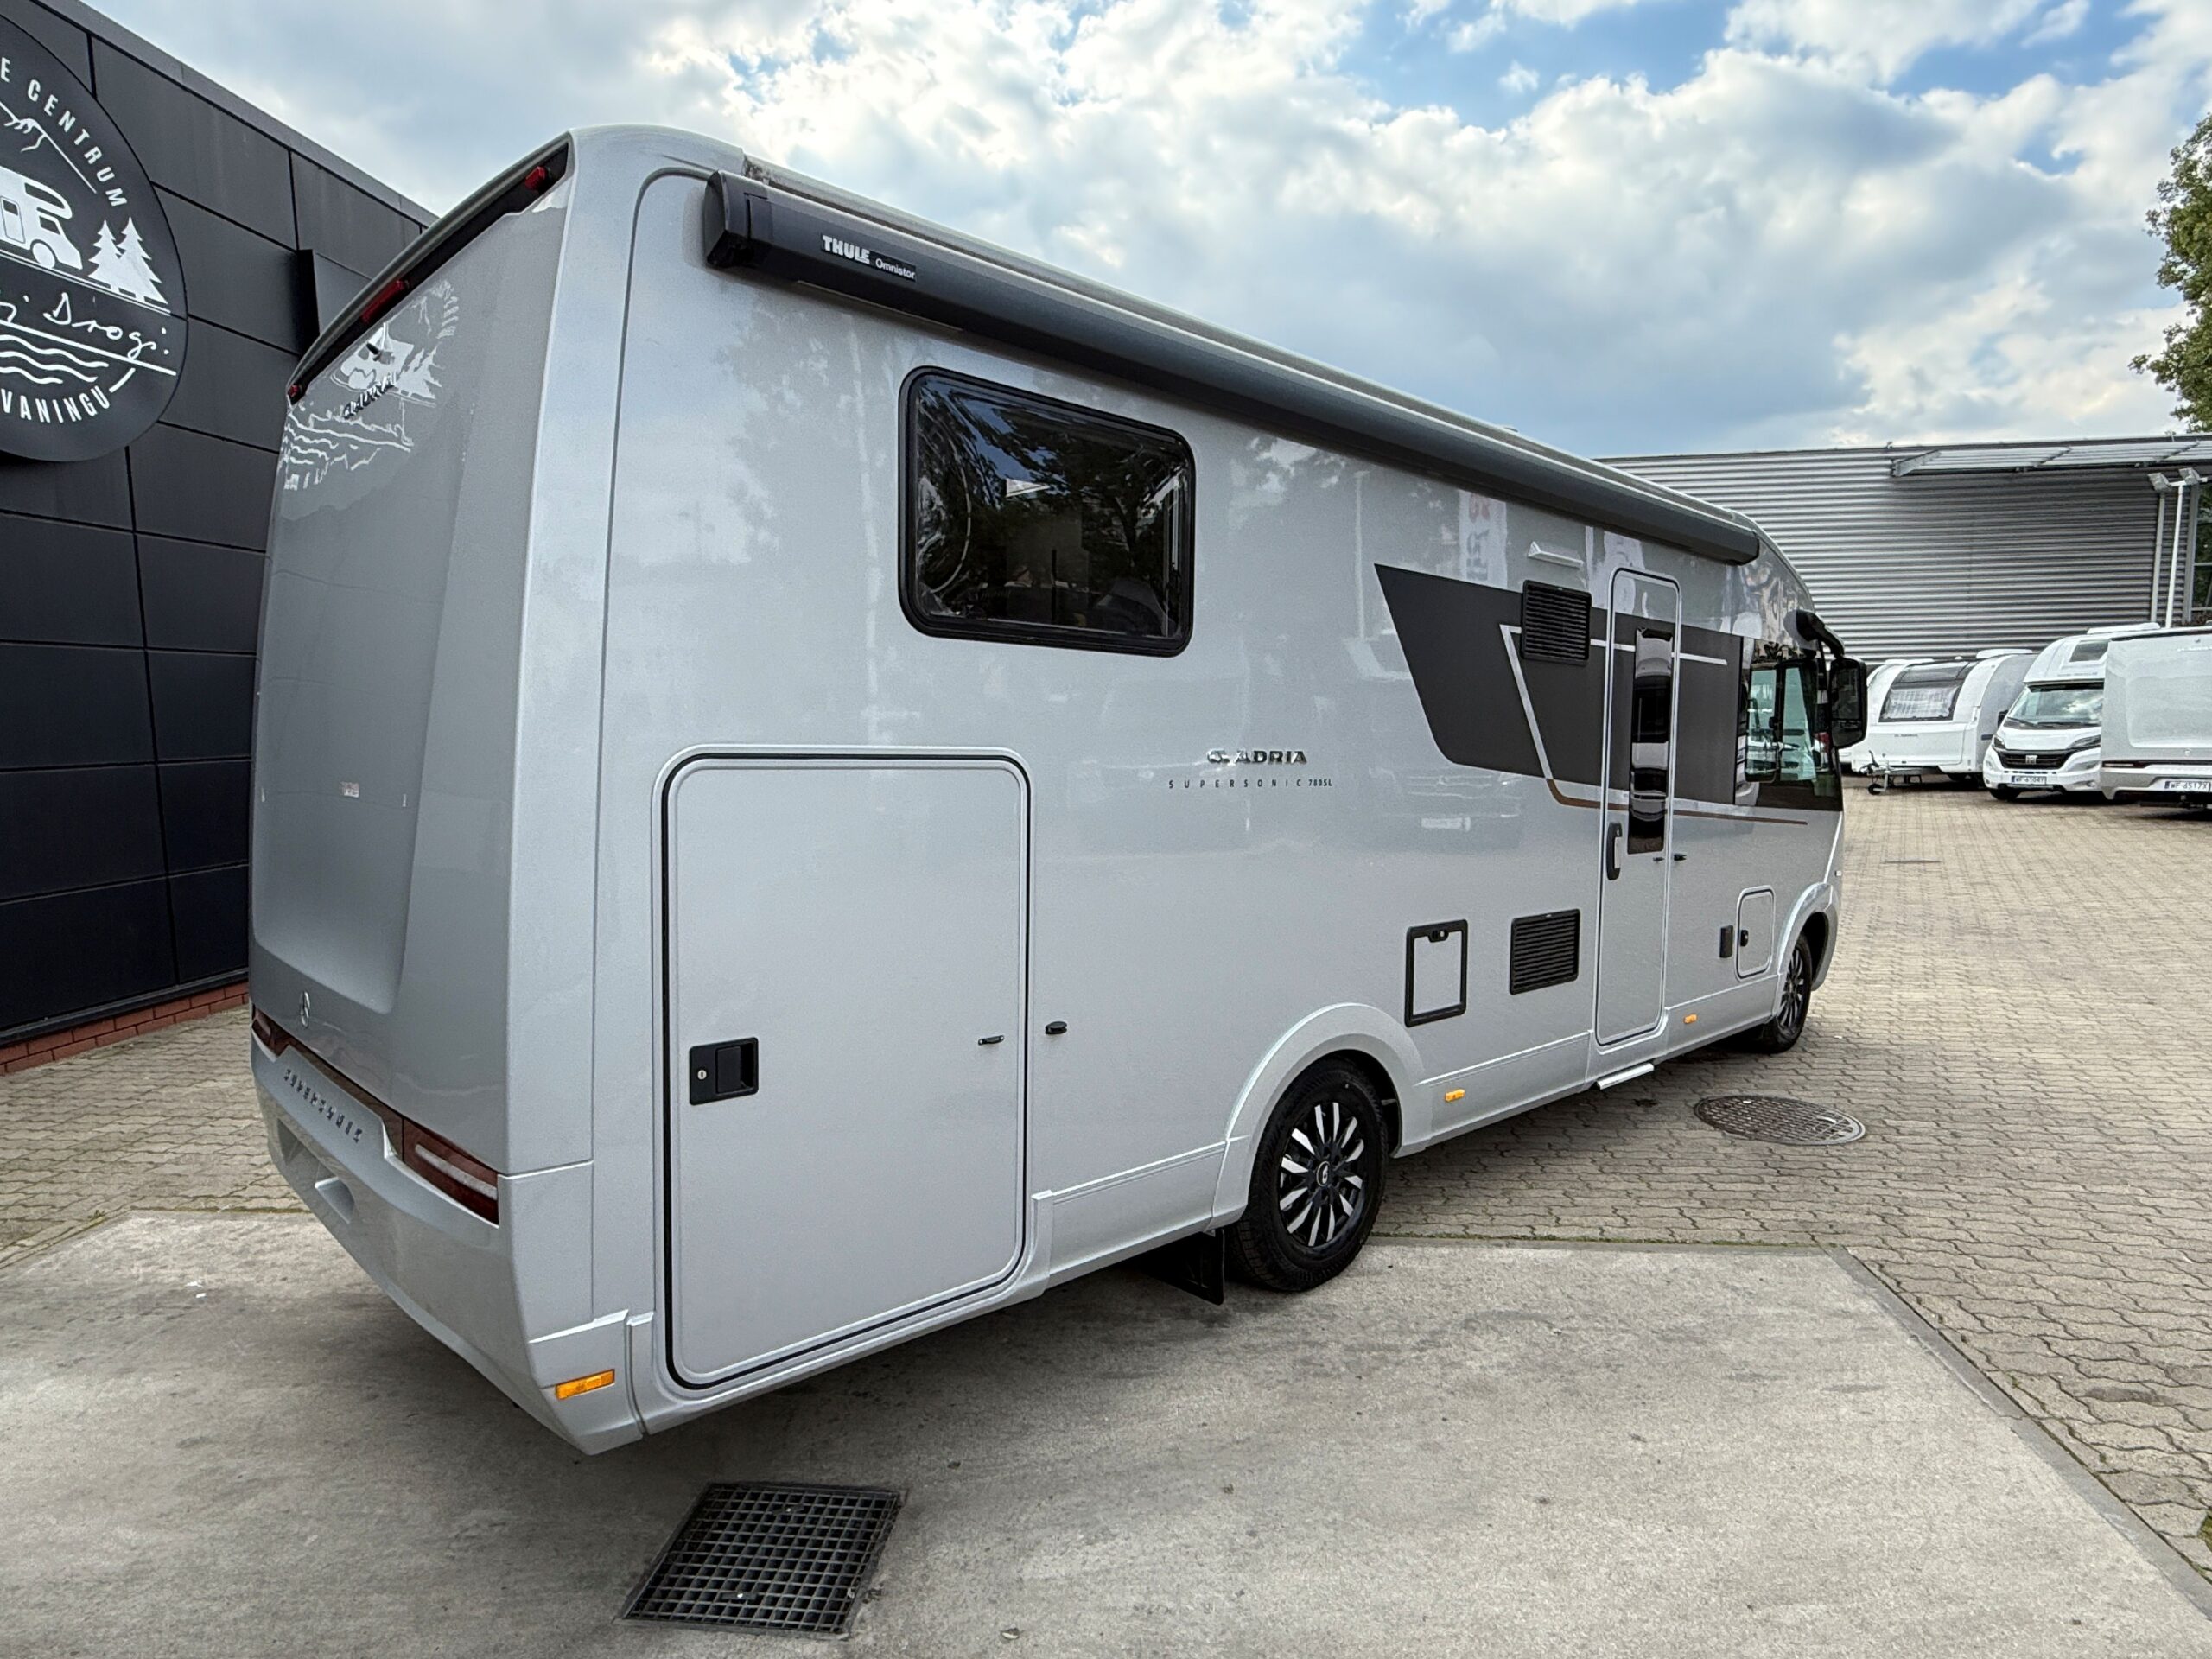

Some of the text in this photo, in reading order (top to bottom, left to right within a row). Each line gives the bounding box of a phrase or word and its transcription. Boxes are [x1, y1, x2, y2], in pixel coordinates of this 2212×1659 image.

[27, 79, 128, 207] CENTRUM
[823, 235, 916, 280] THULE Omnistor
[1, 385, 111, 423] VANINGU
[1168, 779, 1302, 789] SUPERSONIC
